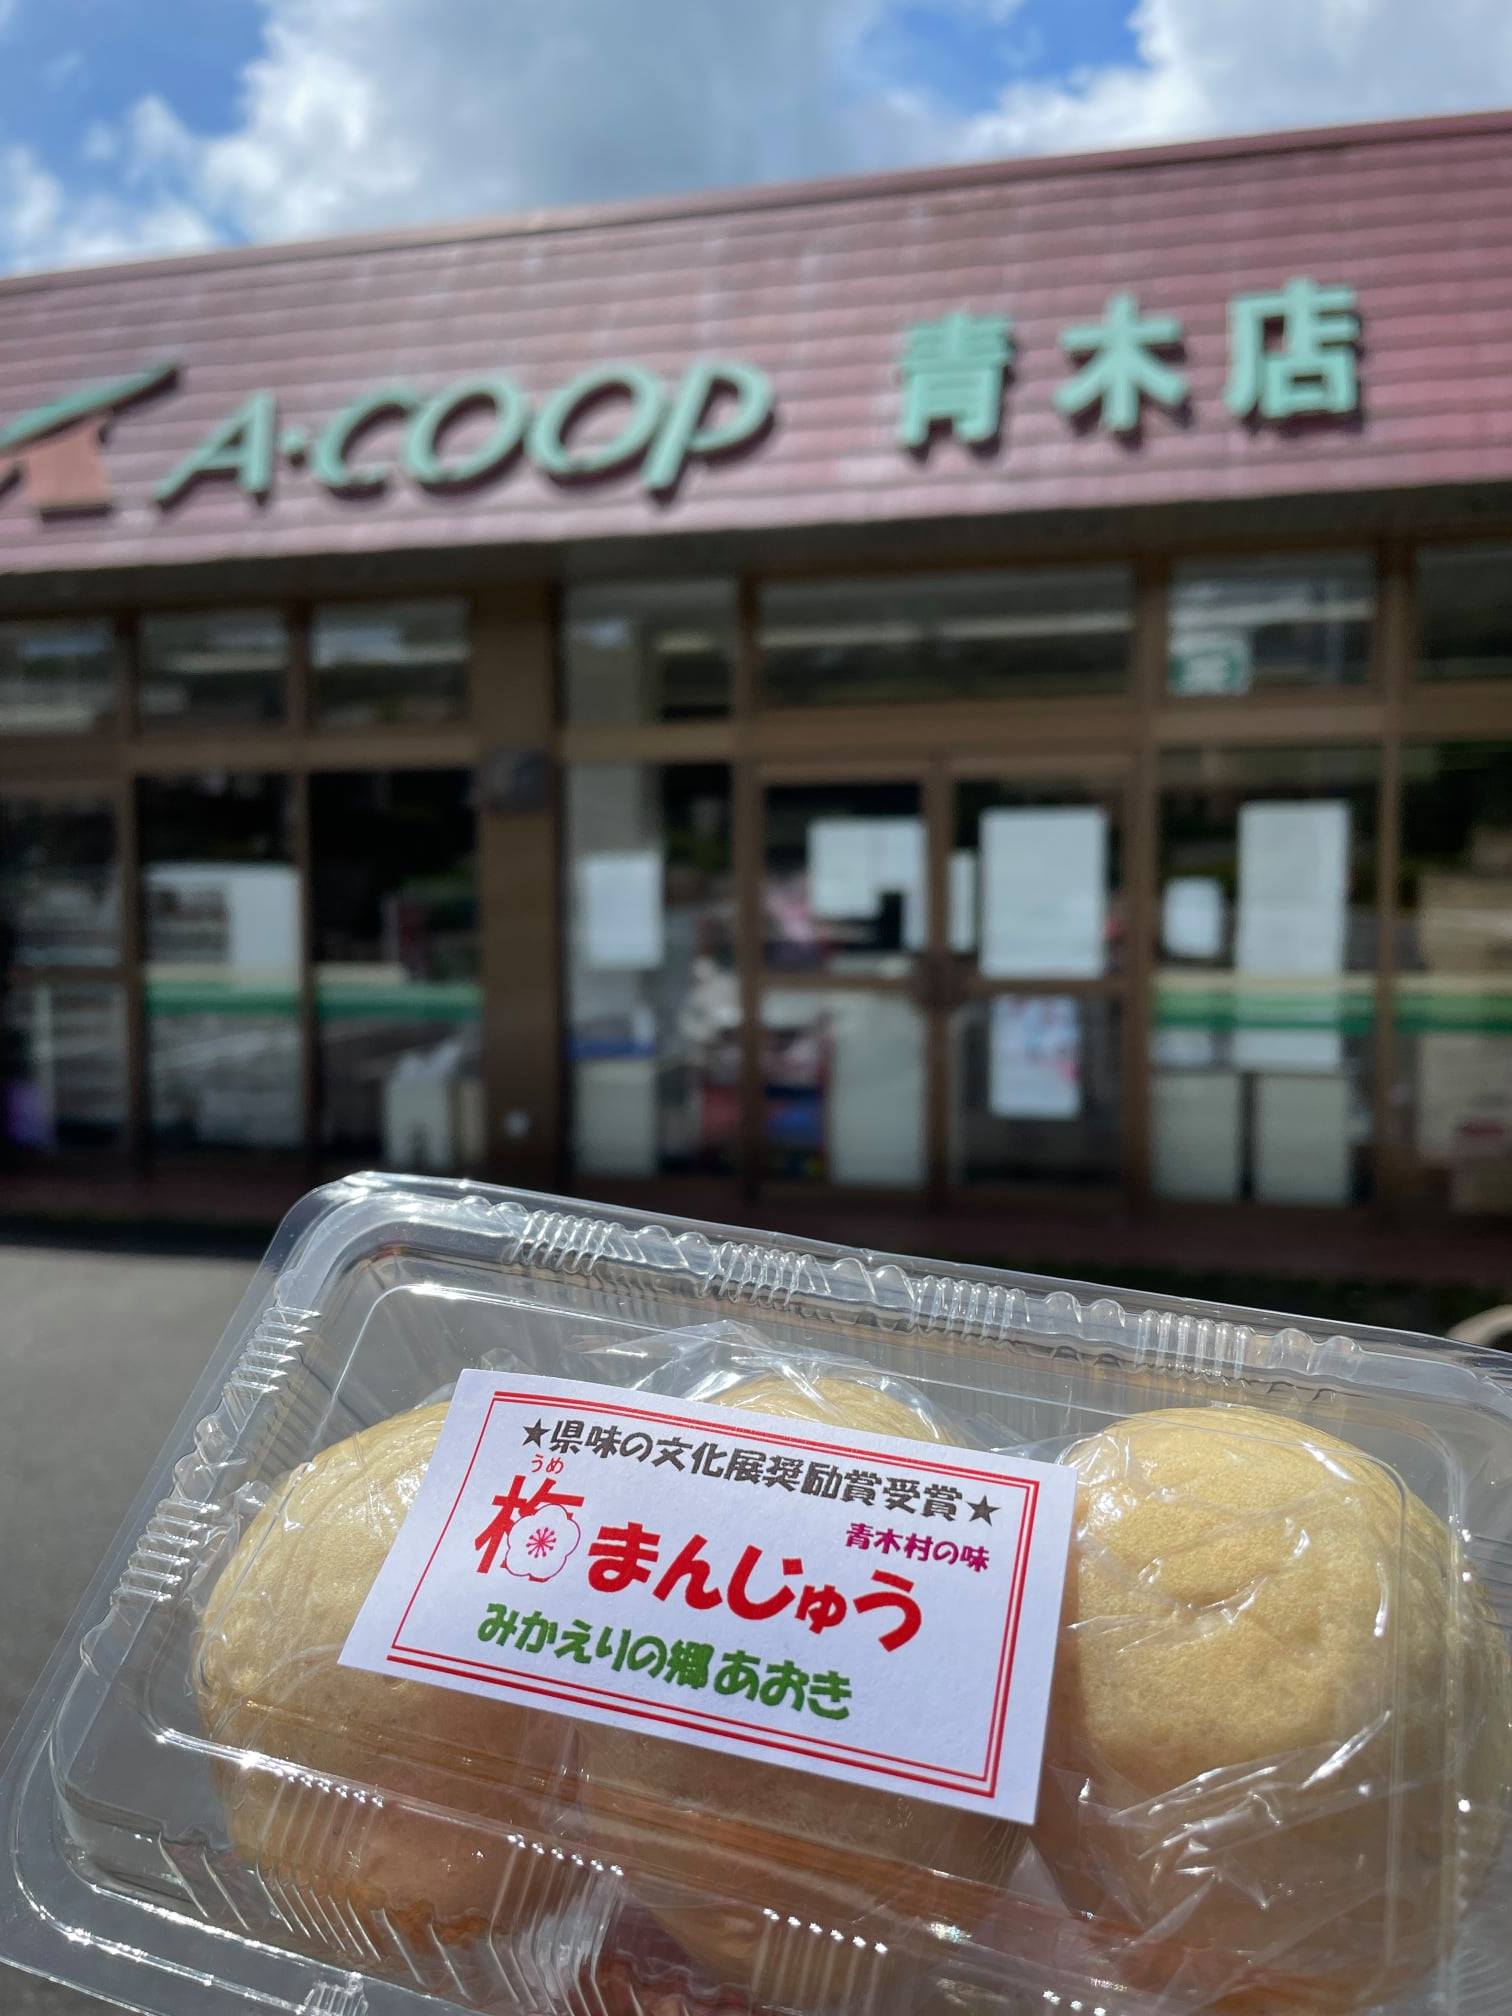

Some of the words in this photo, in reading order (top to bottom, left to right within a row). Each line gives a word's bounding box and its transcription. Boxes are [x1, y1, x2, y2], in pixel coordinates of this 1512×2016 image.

[897, 277, 1360, 446] 青木店
[531, 1453, 564, 1474] うめ
[845, 1522, 990, 1573] 青木村の味
[478, 1603, 852, 1720] みかえりの郷あおき
